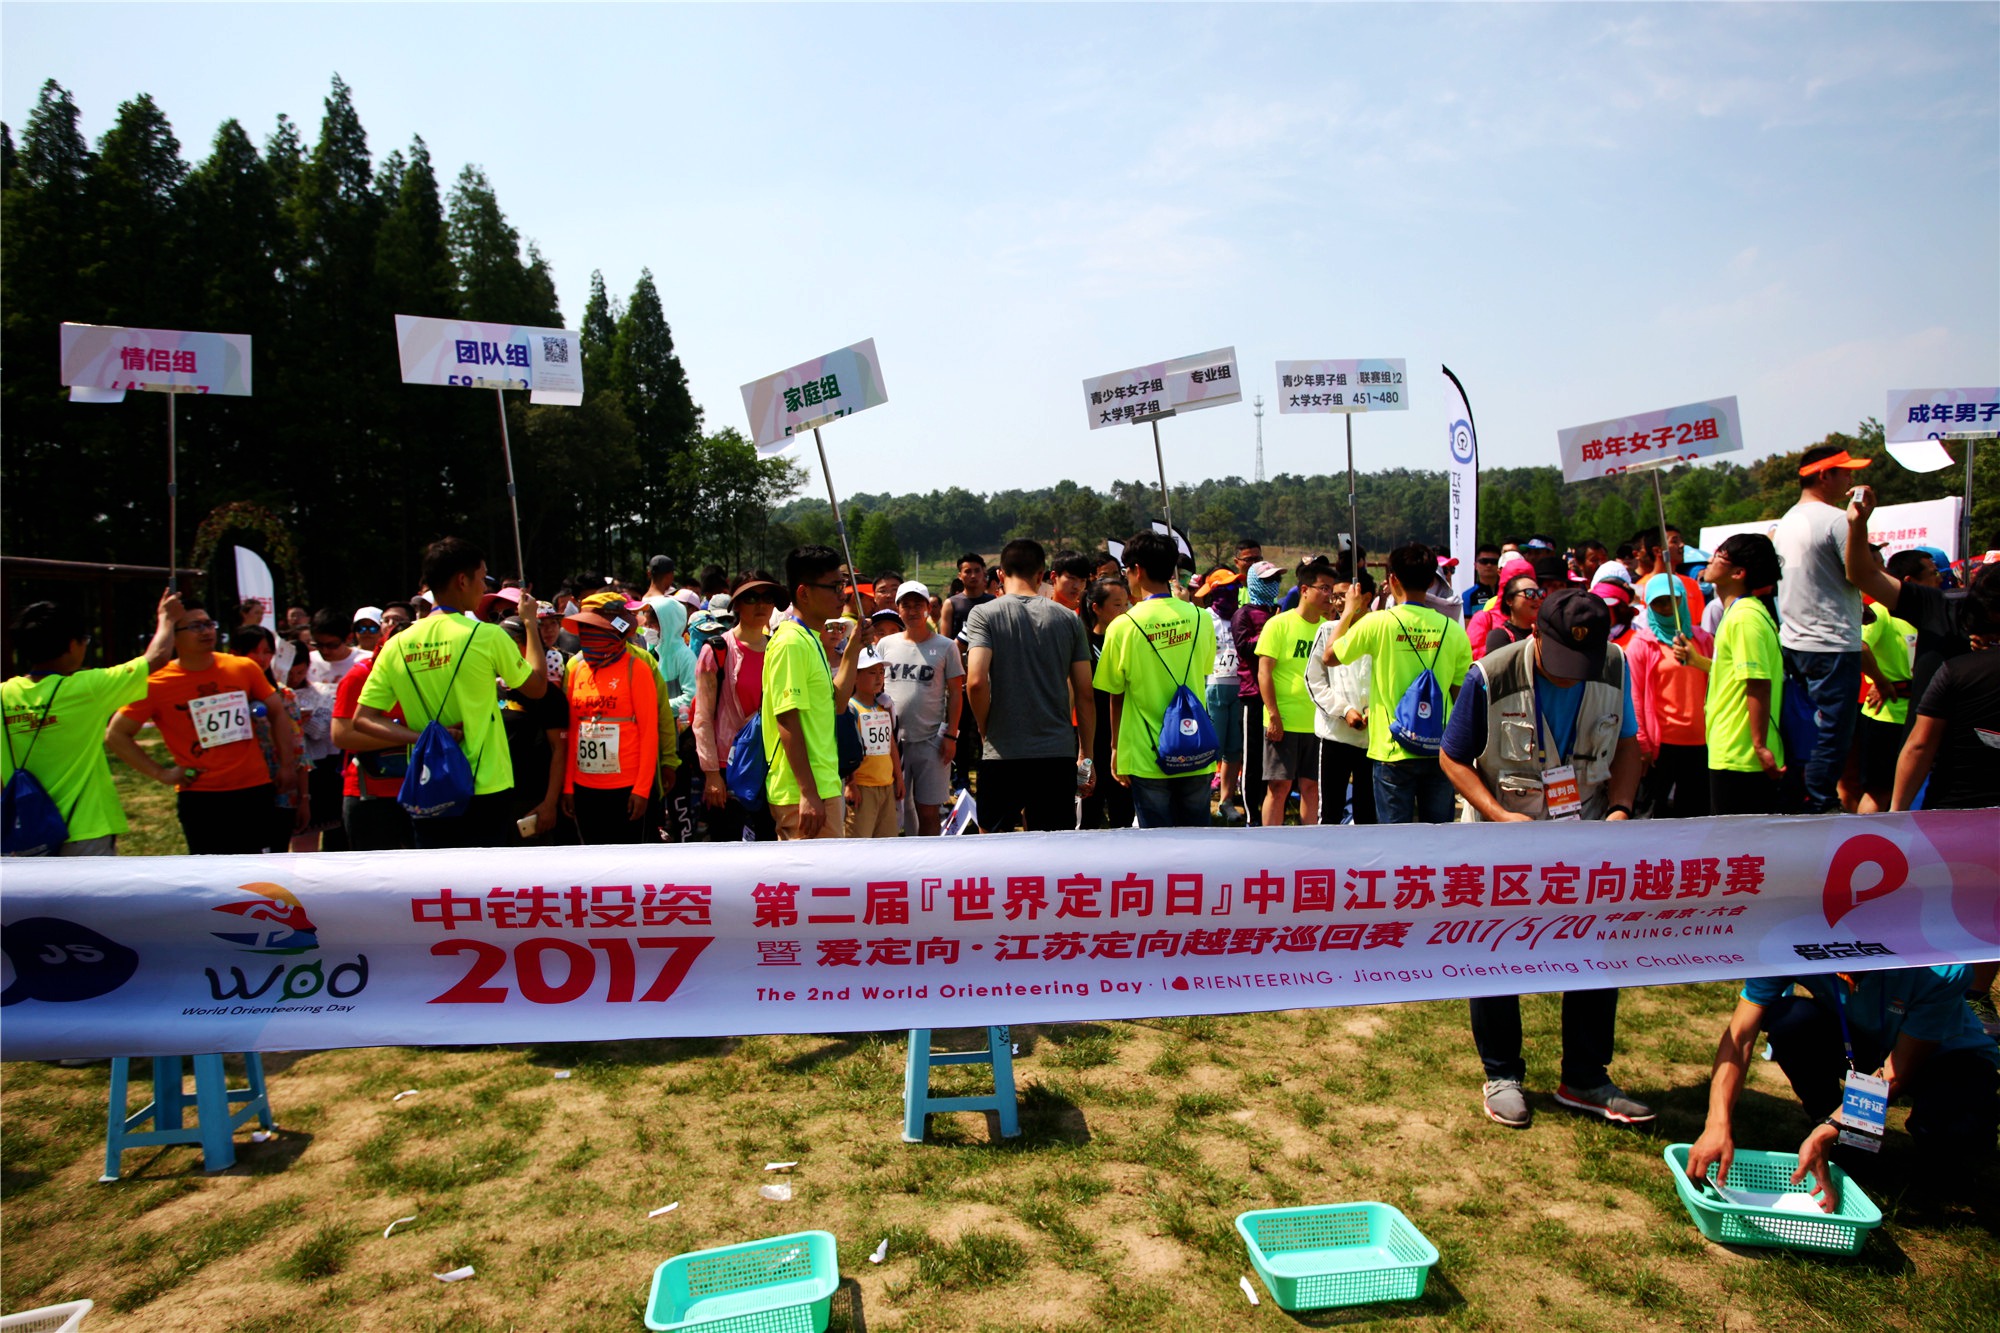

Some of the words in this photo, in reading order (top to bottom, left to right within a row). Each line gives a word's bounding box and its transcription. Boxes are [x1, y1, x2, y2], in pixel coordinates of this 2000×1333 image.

[121, 347, 197, 373] 情侣组
[455, 339, 530, 368] 团队组
[1191, 365, 1231, 384] 专业组
[1282, 373, 1347, 387] 青少年男子组
[1360, 371, 1392, 384] 联赛组
[783, 374, 841, 413] 家庭组
[1091, 378, 1164, 406] 青少年女子组
[1289, 393, 1344, 407] 大学女子组
[1353, 391, 1399, 404] 451~480
[1100, 400, 1160, 424] 大学男子组
[1907, 403, 2000, 423] 成年男子
[1581, 418, 1719, 462] 成年女子2组
[889, 663, 935, 681] YKD
[207, 708, 245, 732] 676
[869, 726, 890, 744] 568
[579, 740, 607, 760] 581
[411, 883, 712, 930] 中铁投资
[757, 940, 802, 966] 暨
[1426, 915, 1597, 952] 2017/5/20
[39, 944, 105, 965] JS
[425, 936, 716, 1005] 2017
[756, 988, 796, 1001] The
[807, 987, 850, 1001] 2nd
[862, 985, 928, 999] World
[940, 979, 1089, 998] Orienteering
[1353, 967, 1433, 983] Jiangsu
[1442, 959, 1579, 978] Orienteering
[1584, 957, 1629, 972] Tour
[1636, 951, 1745, 969] Challenge
[182, 1006, 228, 1016] World
[230, 1003, 324, 1016] Orienteering
[325, 1003, 356, 1014] Day
[1846, 1093, 1884, 1115] 工作证
